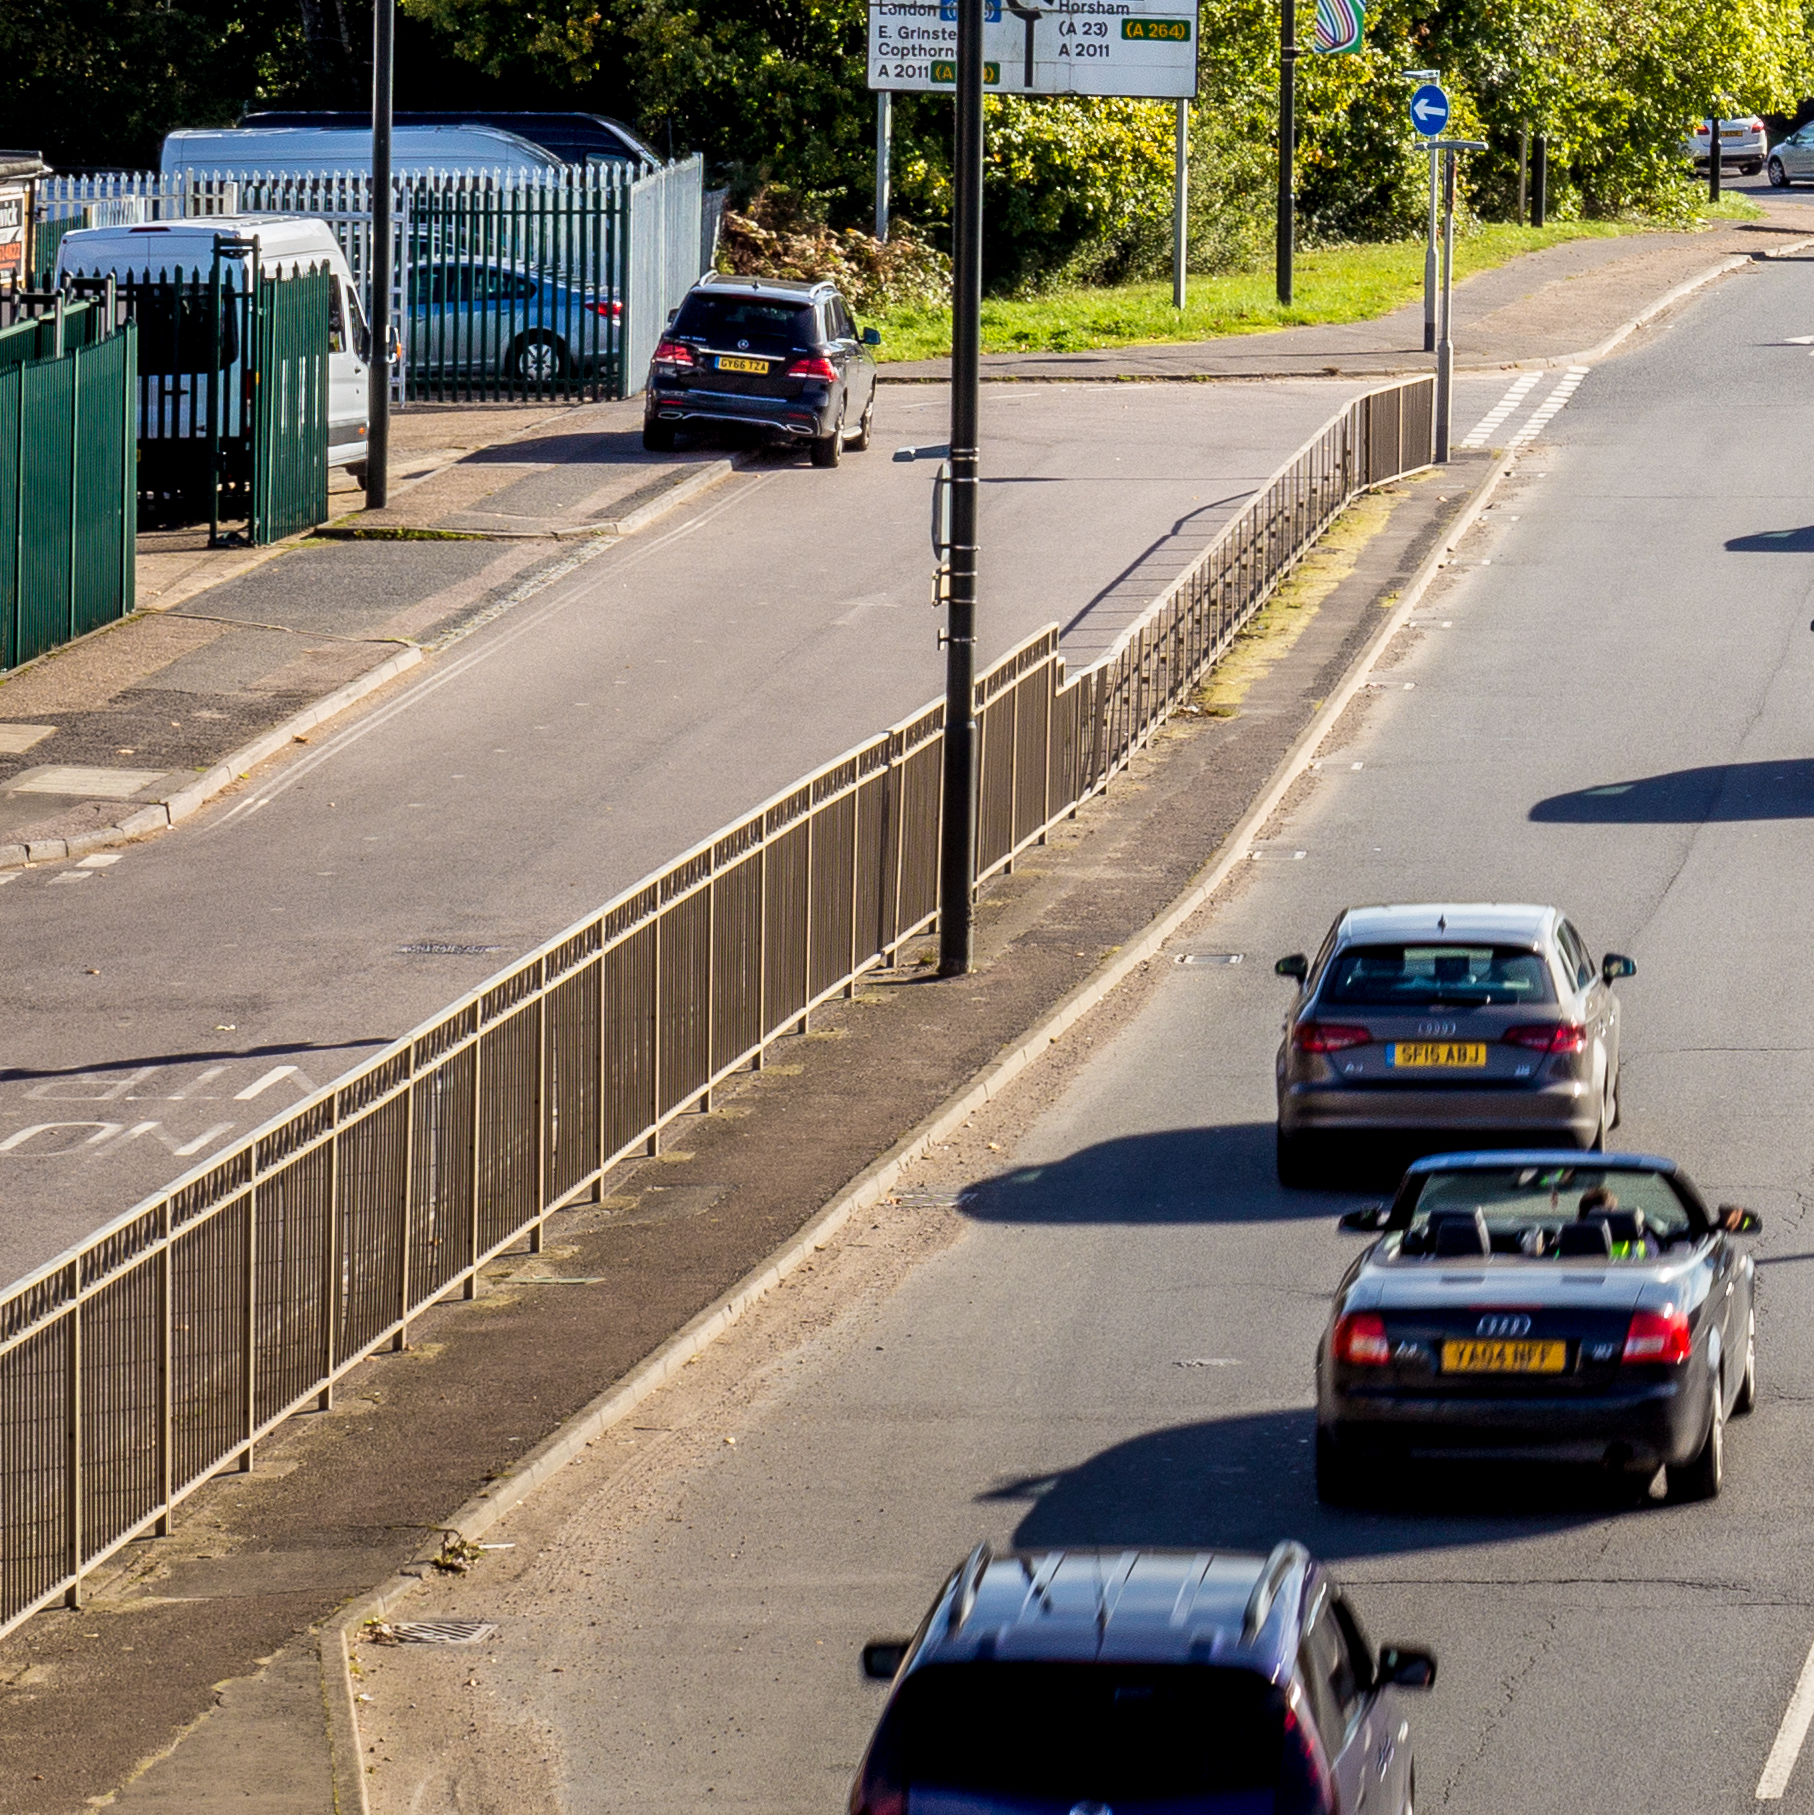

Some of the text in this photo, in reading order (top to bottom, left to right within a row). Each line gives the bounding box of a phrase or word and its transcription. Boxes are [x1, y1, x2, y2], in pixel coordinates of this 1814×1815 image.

[1059, 0, 1131, 16] Horsham
[878, 25, 958, 41] E. Grinste
[1077, 22, 1109, 37] 23)
[1148, 23, 1186, 39] 264)
[878, 42, 958, 60] Copthorn
[1058, 44, 1110, 58] A 2011
[878, 64, 890, 78] A
[894, 65, 929, 79] 2011
[720, 357, 767, 372] GY66 TZA
[1444, 1043, 1480, 1064] ABJ
